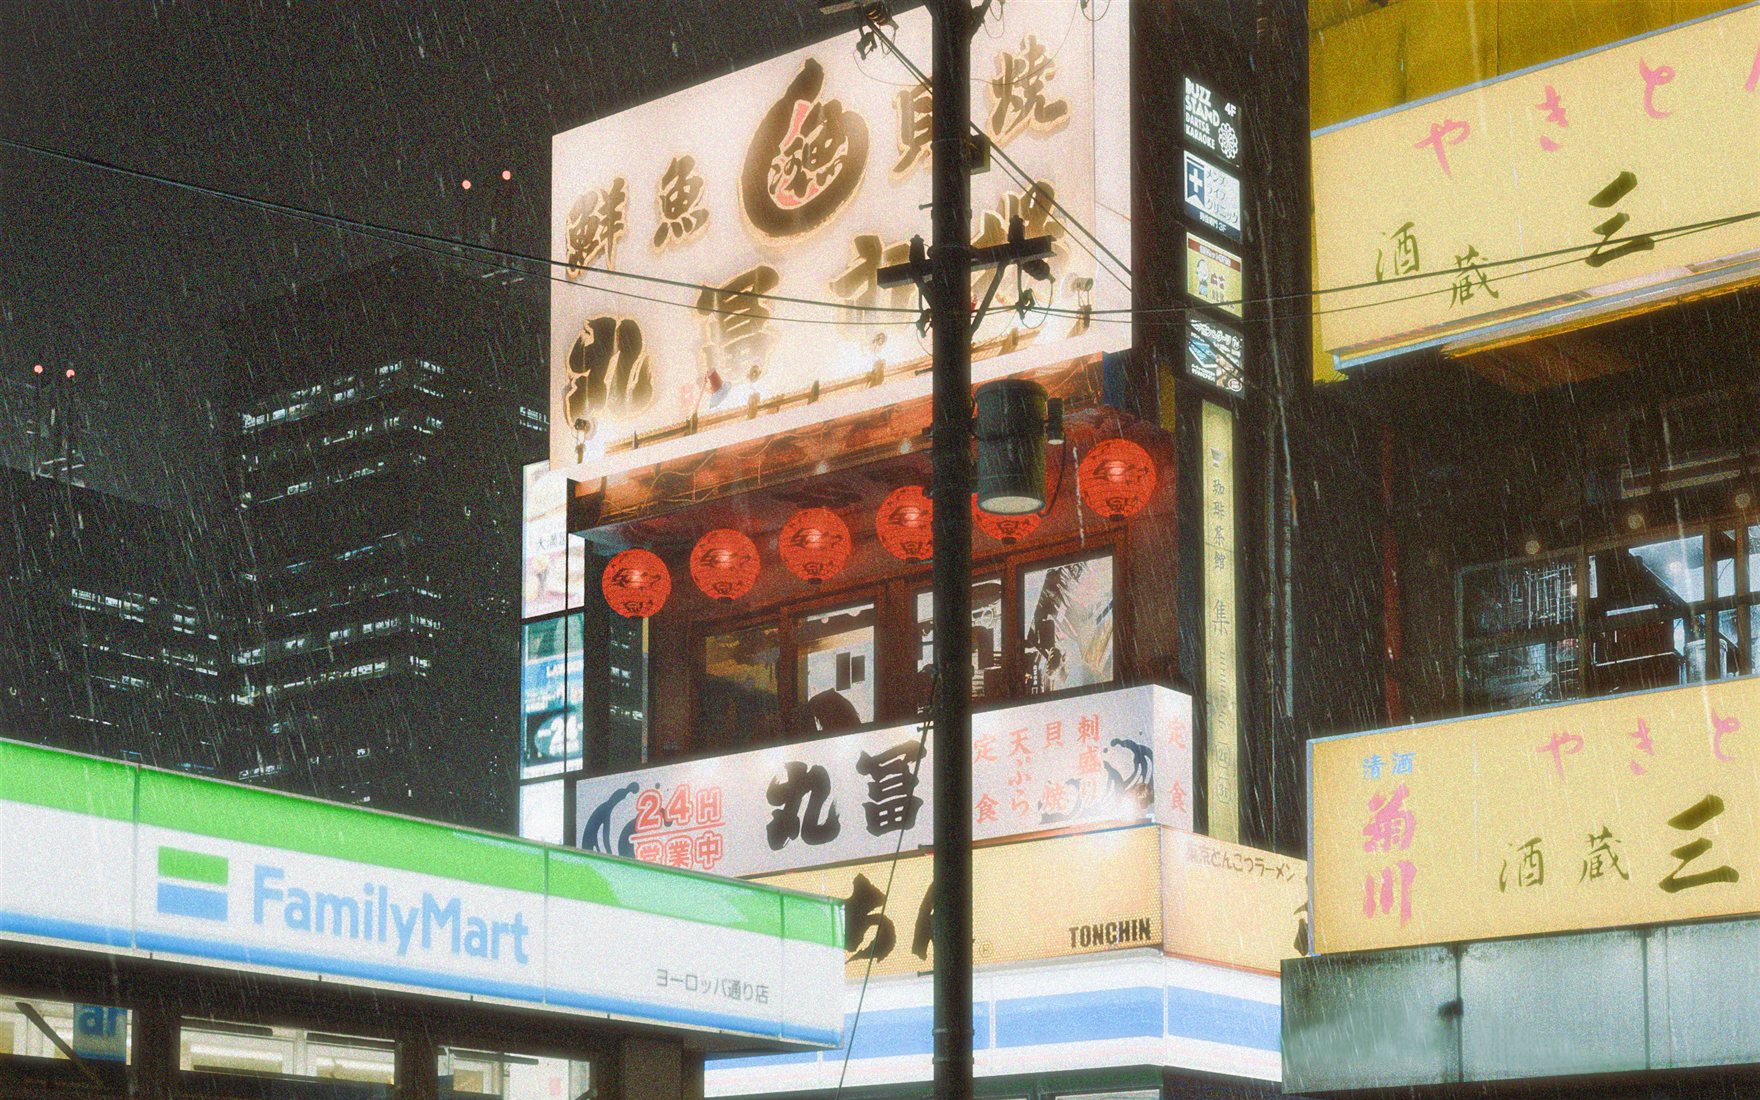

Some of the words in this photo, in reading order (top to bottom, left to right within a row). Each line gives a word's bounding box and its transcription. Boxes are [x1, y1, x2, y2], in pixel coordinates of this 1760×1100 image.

[1185, 77, 1212, 107] BUZZ
[1185, 95, 1220, 127] STAND
[1224, 101, 1237, 118] 4F
[1185, 124, 1216, 151] KARAOKE
[565, 155, 711, 278] 鮮魚
[1008, 727, 1035, 817] 天ぷら
[1167, 718, 1188, 814] 定食
[1536, 707, 1740, 783] やきと
[634, 782, 723, 834] 24H
[974, 733, 999, 824] 定食
[1362, 783, 1418, 930] 菊川
[254, 865, 530, 965] FamilyMart
[1068, 917, 1152, 949] TONCHIN
[656, 967, 769, 1004] ヨーロッパ通り店
